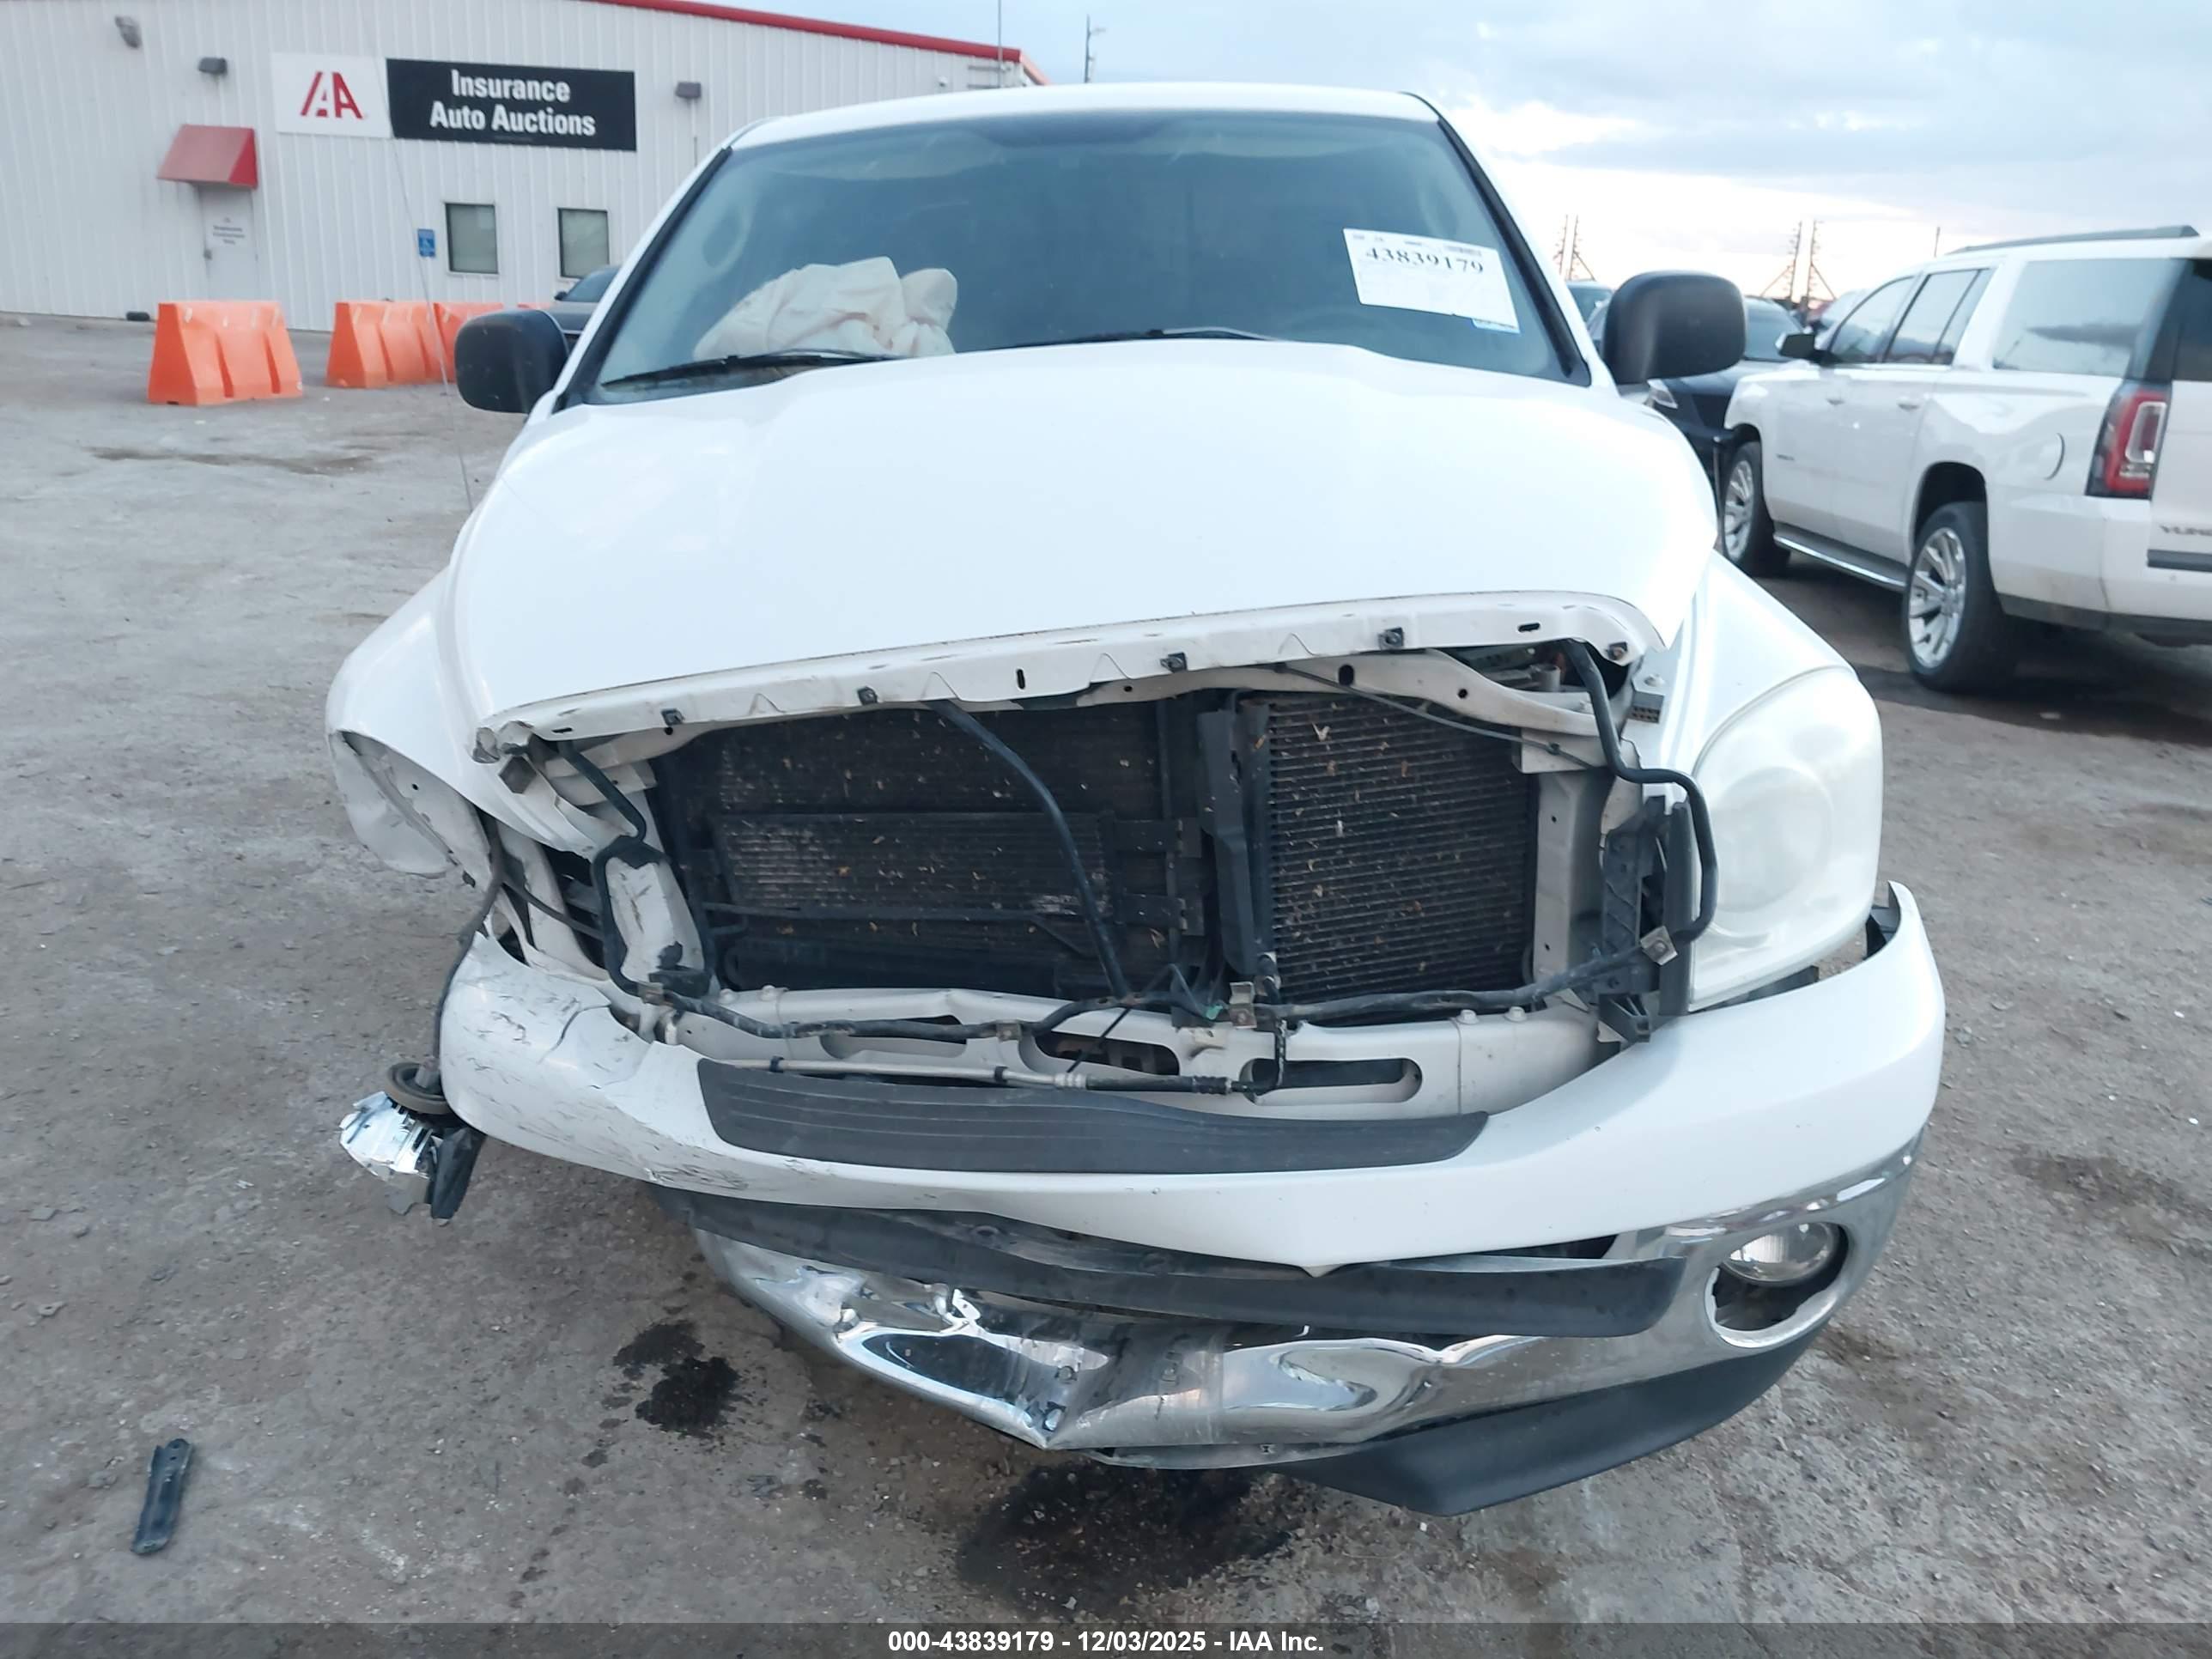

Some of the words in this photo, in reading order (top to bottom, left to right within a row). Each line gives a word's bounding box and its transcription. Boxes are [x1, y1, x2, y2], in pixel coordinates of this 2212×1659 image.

[451, 69, 571, 102] Insurance
[429, 100, 487, 130] Auto
[491, 104, 597, 137] Auctions
[1364, 246, 1484, 273] 43839179
